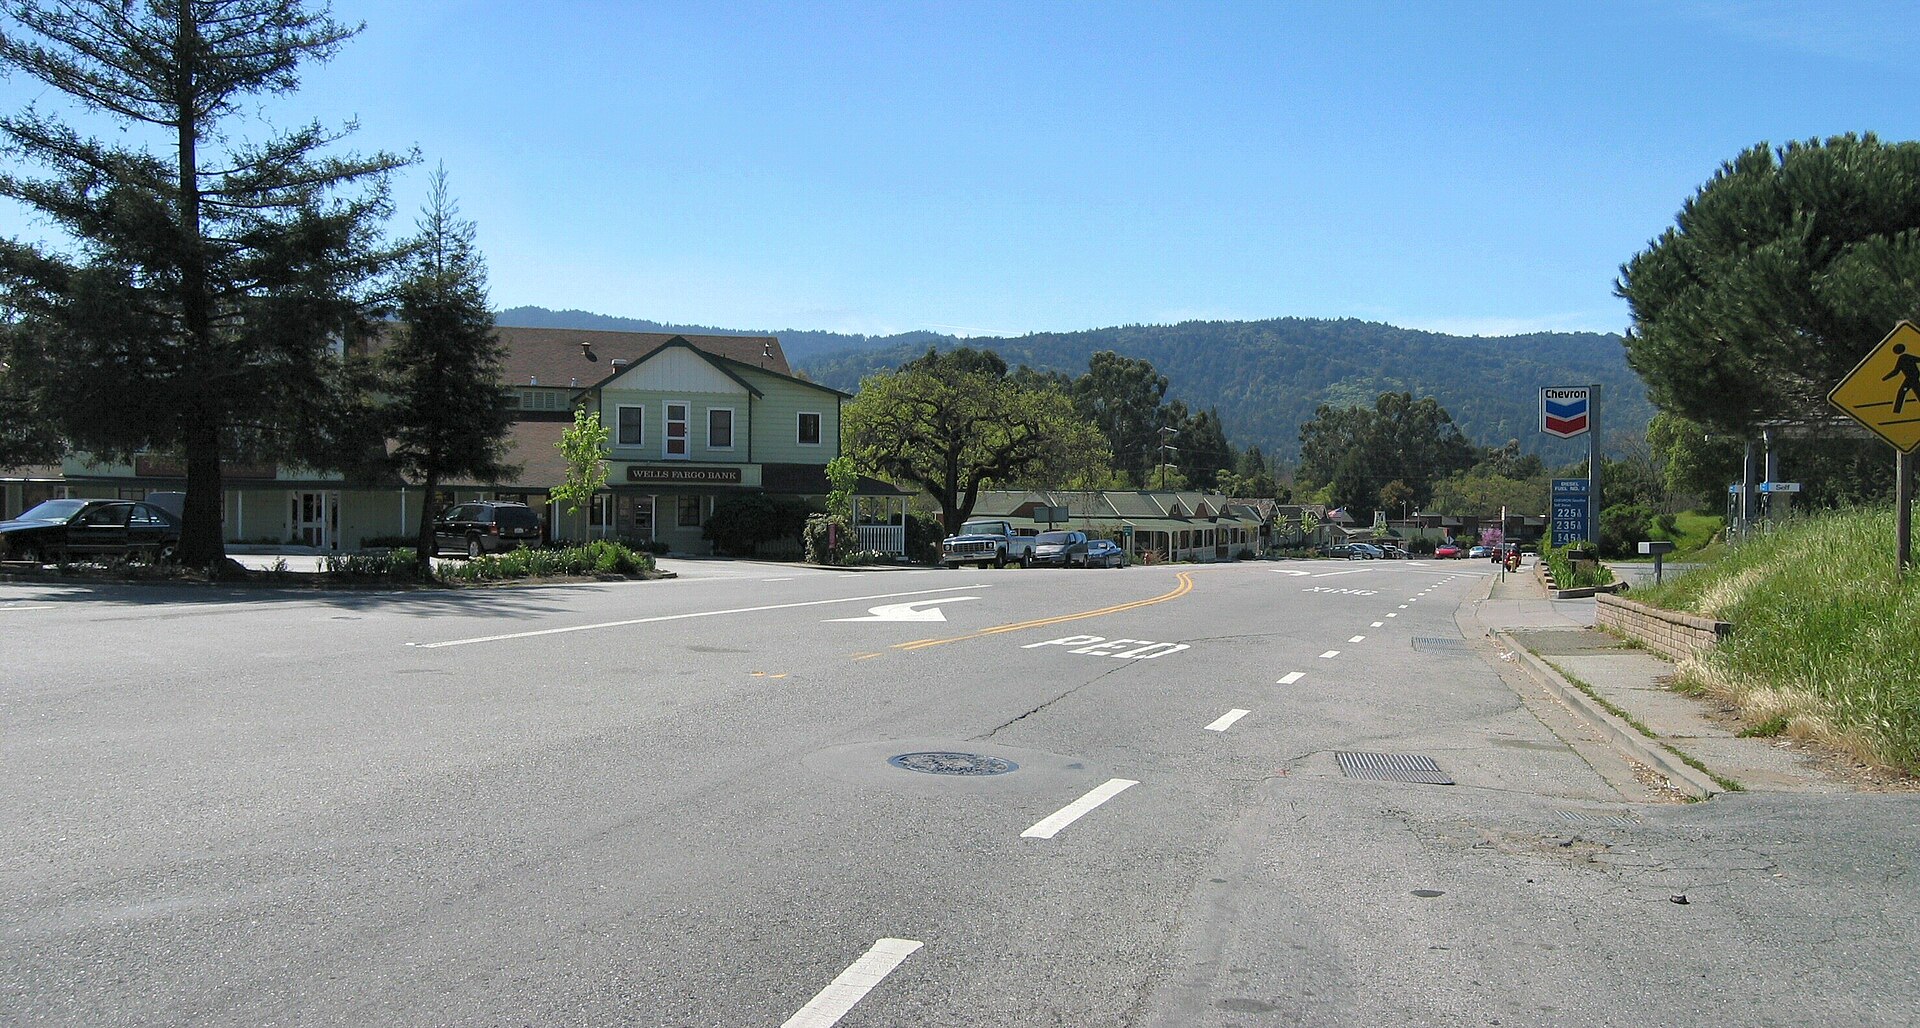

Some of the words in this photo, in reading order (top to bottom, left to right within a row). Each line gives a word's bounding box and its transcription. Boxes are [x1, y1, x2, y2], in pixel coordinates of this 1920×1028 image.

[1545, 389, 1587, 399] Chevron
[632, 470, 669, 478] WELLS
[672, 471, 705, 479] FARGO
[708, 471, 736, 479] BANK
[1301, 586, 1379, 596] XING
[1020, 634, 1192, 660] PED
